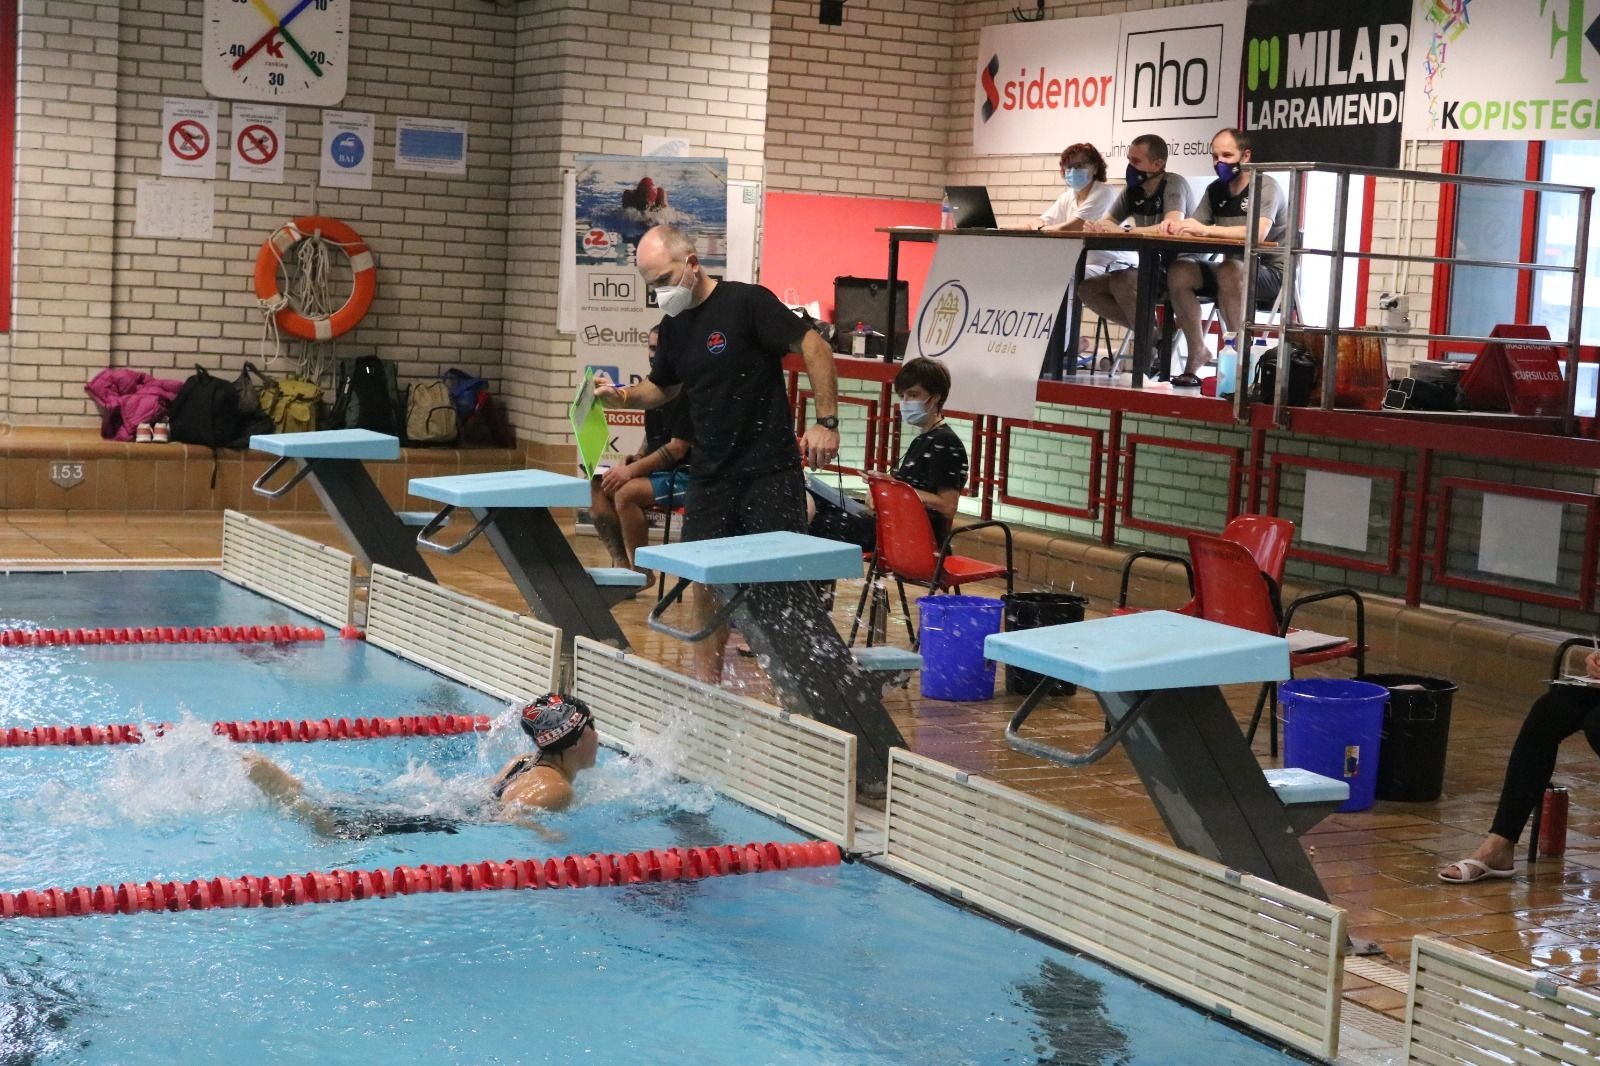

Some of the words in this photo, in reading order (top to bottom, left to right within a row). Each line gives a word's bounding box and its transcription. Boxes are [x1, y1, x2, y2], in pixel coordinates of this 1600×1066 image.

[229, 44, 246, 57] 40
[310, 51, 325, 65] 20
[1286, 23, 1408, 89] MILAR
[268, 72, 285, 86] 30
[1132, 41, 1209, 108] nho
[1002, 66, 1114, 111] sidenor
[1246, 91, 1404, 131] LARRAMENDI
[593, 277, 630, 298] nho
[966, 307, 1053, 340] AZKOITIA
[600, 327, 649, 344] eurite
[987, 341, 1018, 355] Udala
[1513, 370, 1560, 381] CURSILLOS
